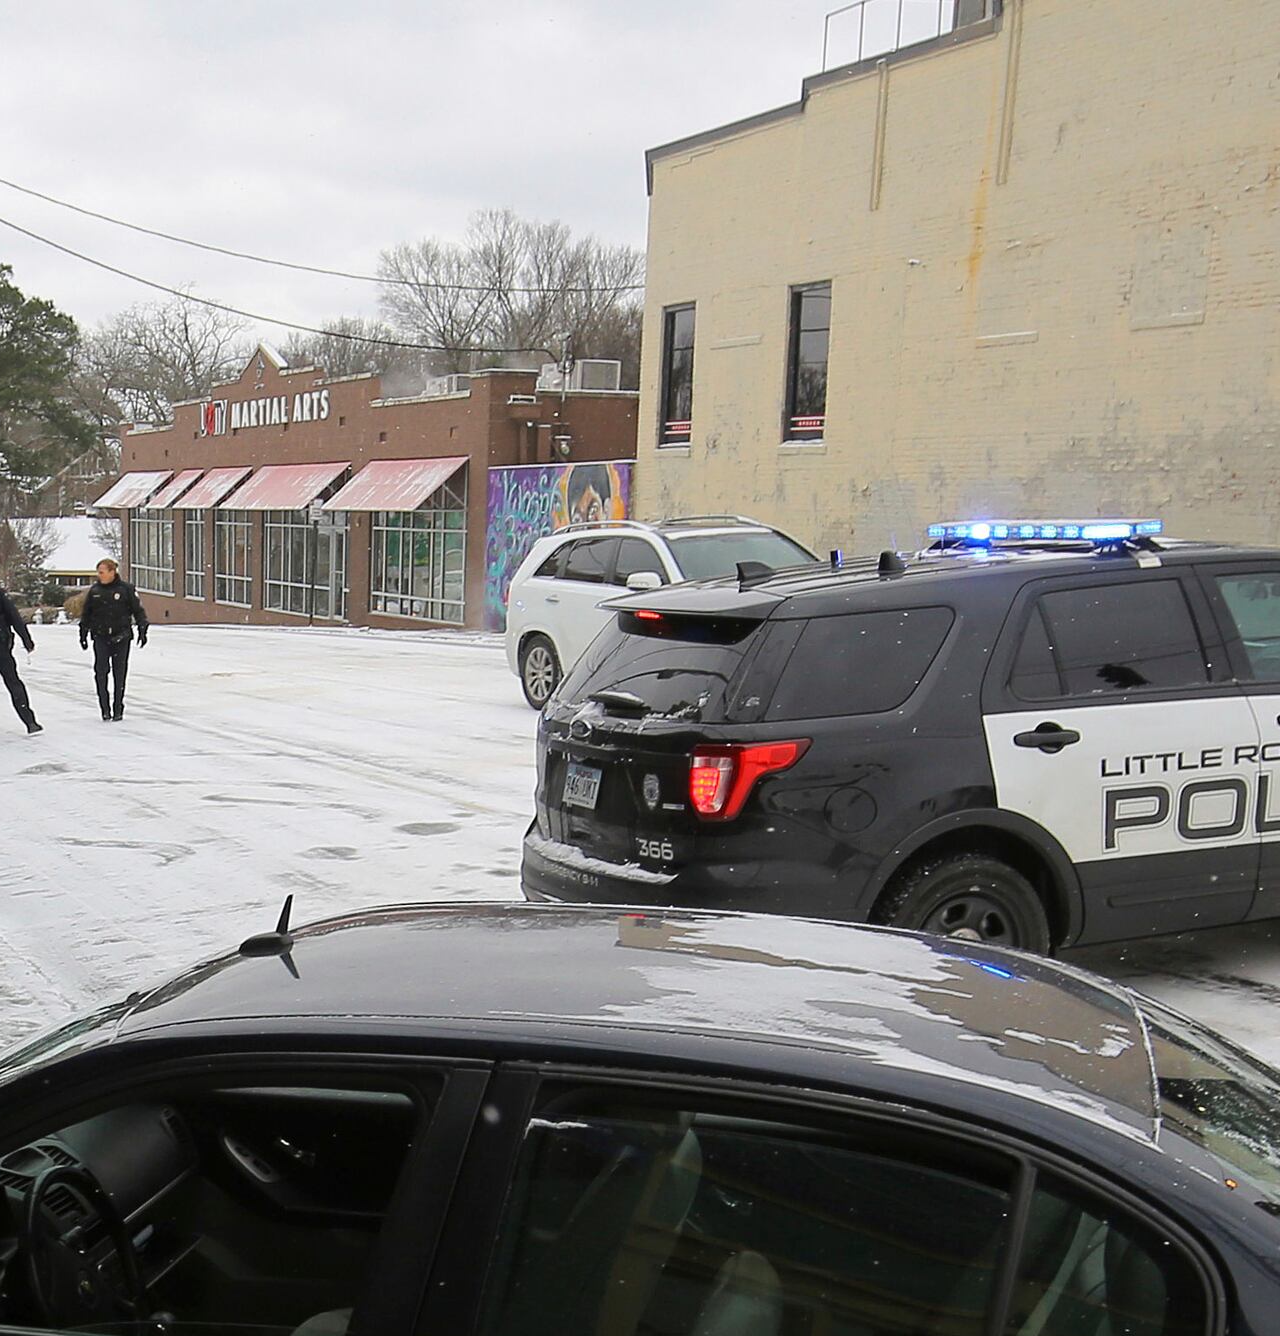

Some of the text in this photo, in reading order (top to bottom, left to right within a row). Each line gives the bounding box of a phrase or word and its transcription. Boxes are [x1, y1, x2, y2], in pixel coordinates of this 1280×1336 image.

[230, 396, 289, 429] MARTIAL
[293, 389, 329, 422] ARTS
[1100, 748, 1224, 778] LITTLE
[638, 839, 674, 861] 366
